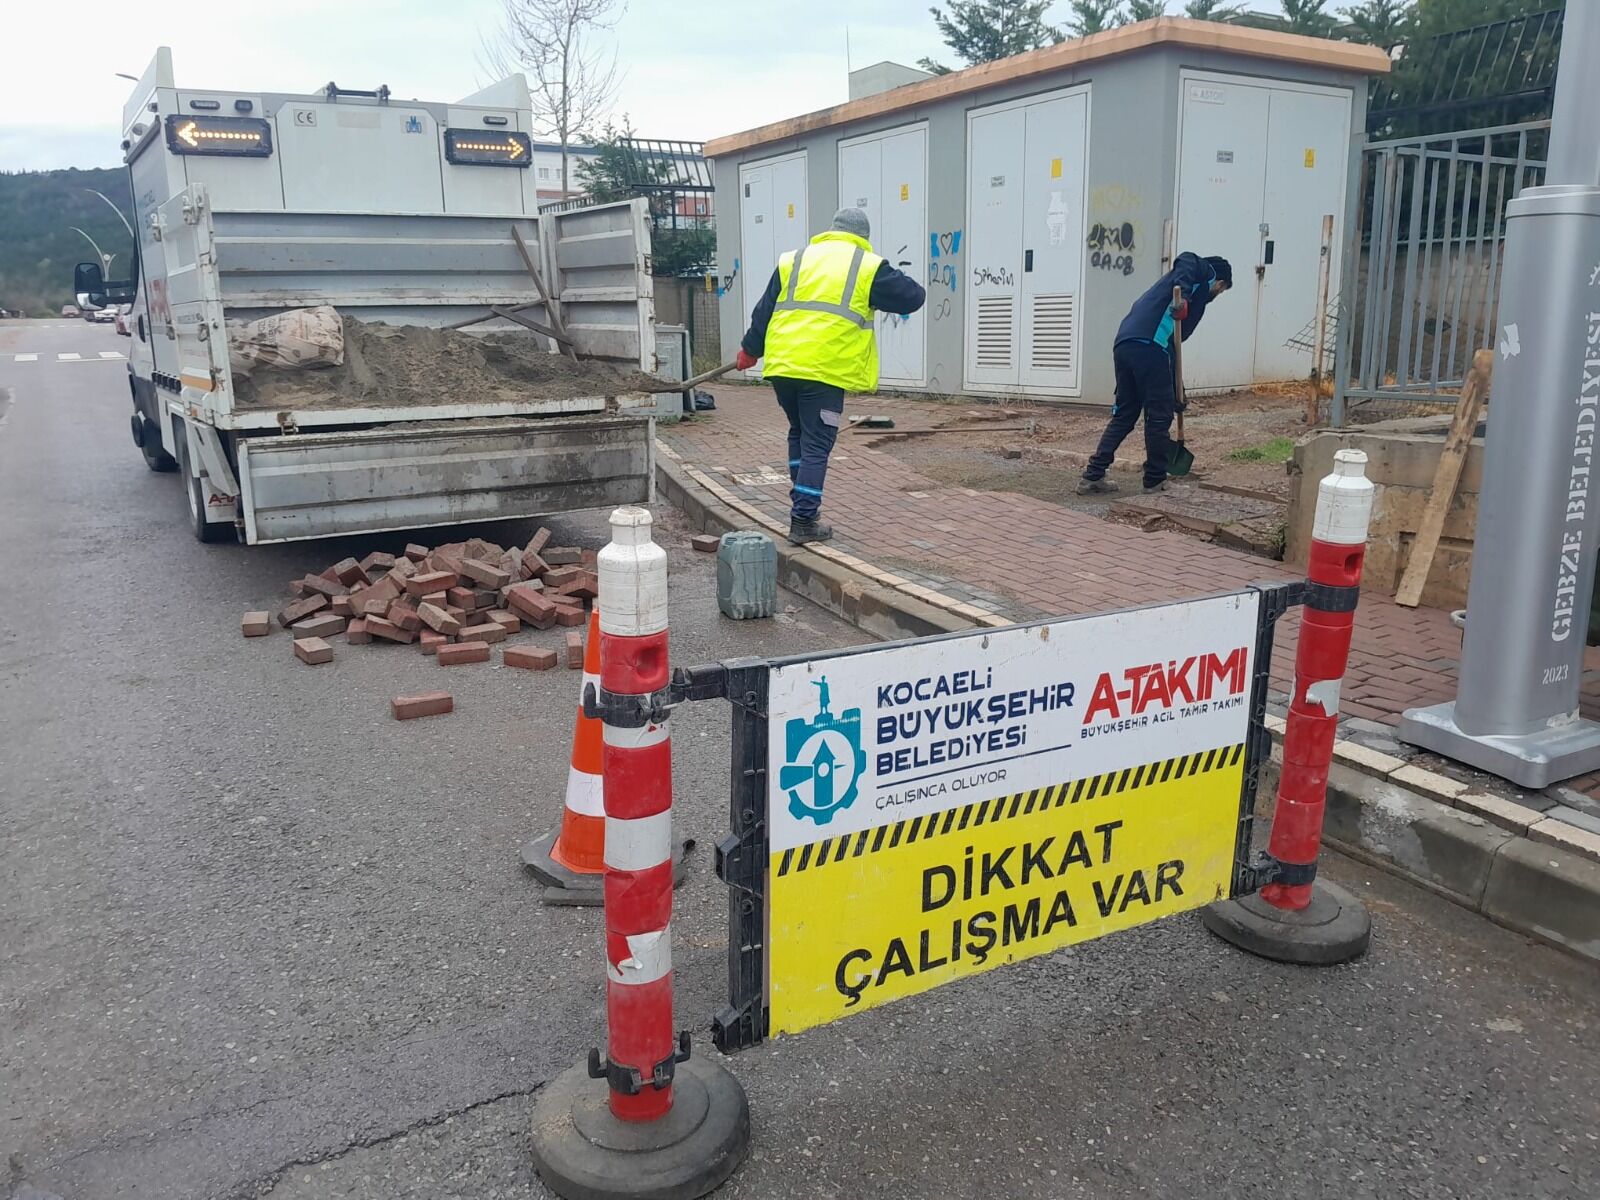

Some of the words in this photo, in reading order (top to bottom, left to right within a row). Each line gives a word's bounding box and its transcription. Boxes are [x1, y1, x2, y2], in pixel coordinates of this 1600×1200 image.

[1552, 530, 1582, 642] GEBZE
[877, 666, 992, 708] KOCAELİ
[1083, 647, 1248, 725] A-TAKIMI
[1542, 664, 1569, 685] 2023
[877, 682, 1075, 745] BÜYÜKŞEHİR
[1081, 716, 1149, 739] BÜYÜKŞEHİR
[1152, 712, 1175, 724] ACİL
[1180, 704, 1209, 719] TAMİR
[1212, 696, 1244, 711] TAKIMI
[876, 724, 1027, 776] BELEDİYESİ
[875, 782, 947, 810] ÇALIŞINCA
[951, 769, 1007, 791] OLUYOR
[921, 820, 1123, 913] DİKKAT
[834, 890, 1077, 1008] ÇALIŞMA
[1092, 858, 1185, 918] VAR
